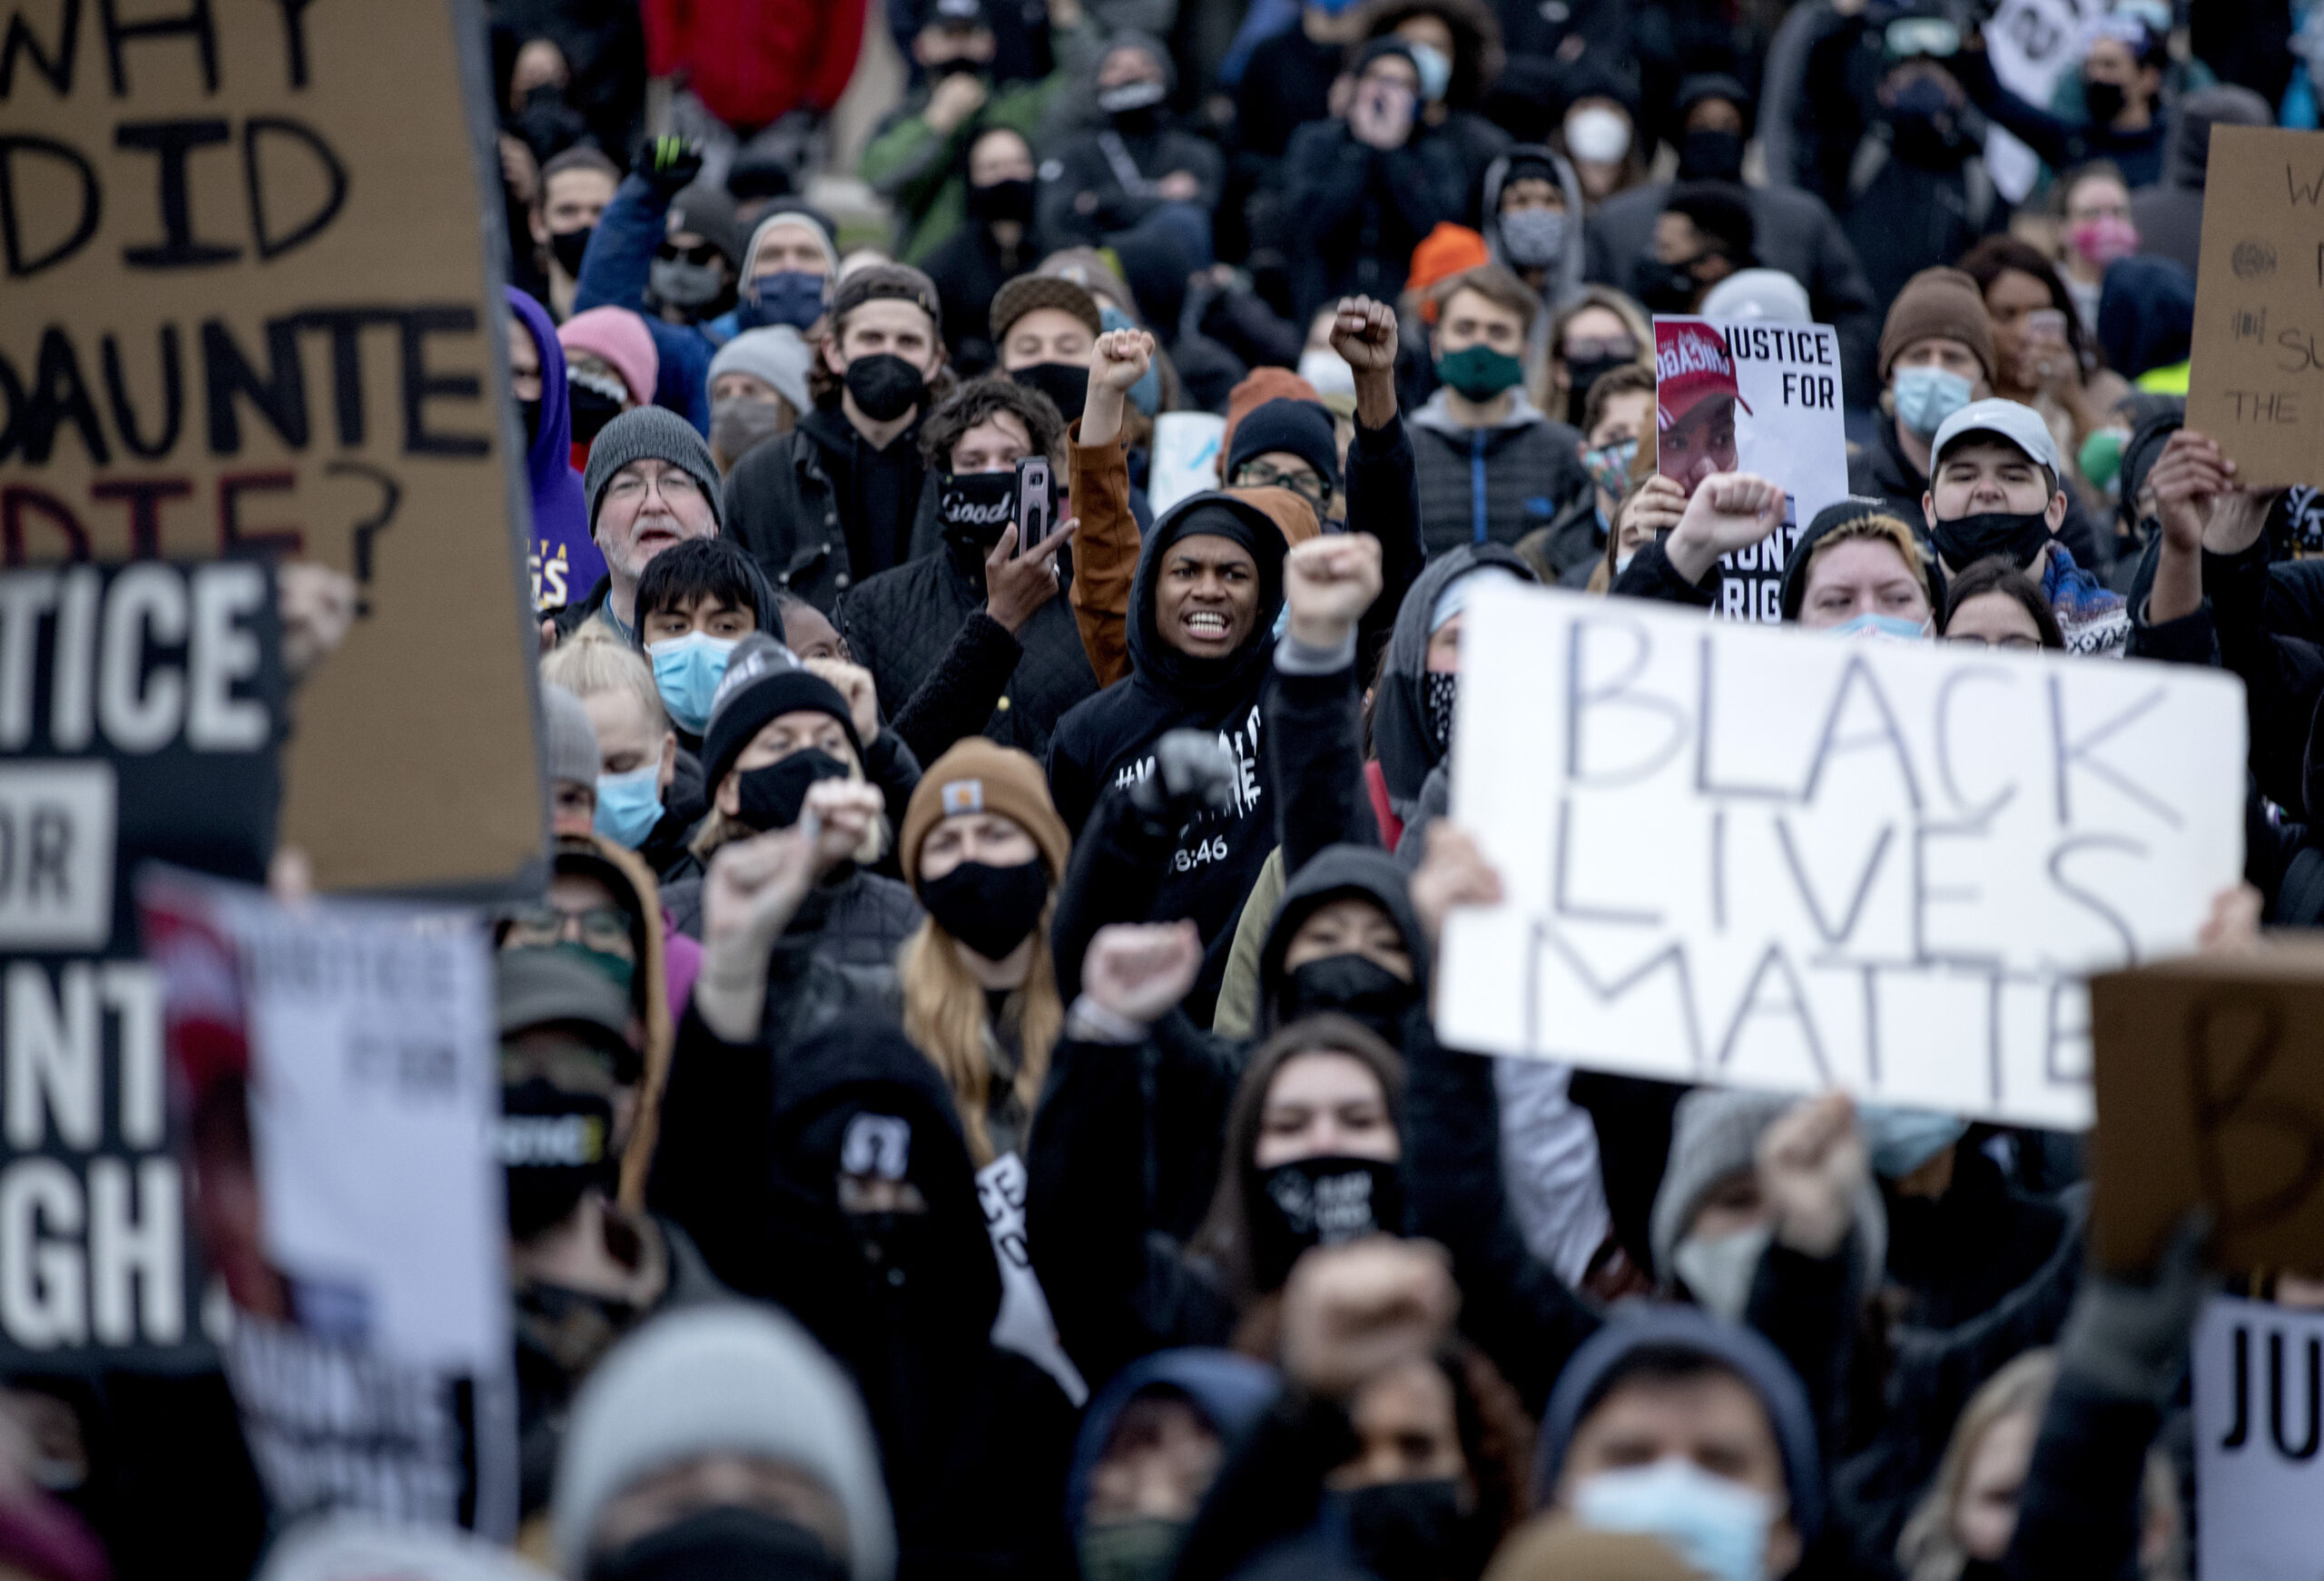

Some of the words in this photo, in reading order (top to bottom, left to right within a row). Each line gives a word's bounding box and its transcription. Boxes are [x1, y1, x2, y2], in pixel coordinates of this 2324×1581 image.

[0, 116, 350, 278] DID
[1718, 325, 1833, 366] JUSTICE
[1782, 371, 1835, 410] FOR
[2225, 391, 2299, 424] THE
[942, 491, 1011, 525] Good
[1563, 615, 2186, 831] BLACK
[1175, 834, 1228, 881] 8:46
[1549, 788, 2148, 973] LIVES
[2219, 1322, 2322, 1465] JU
